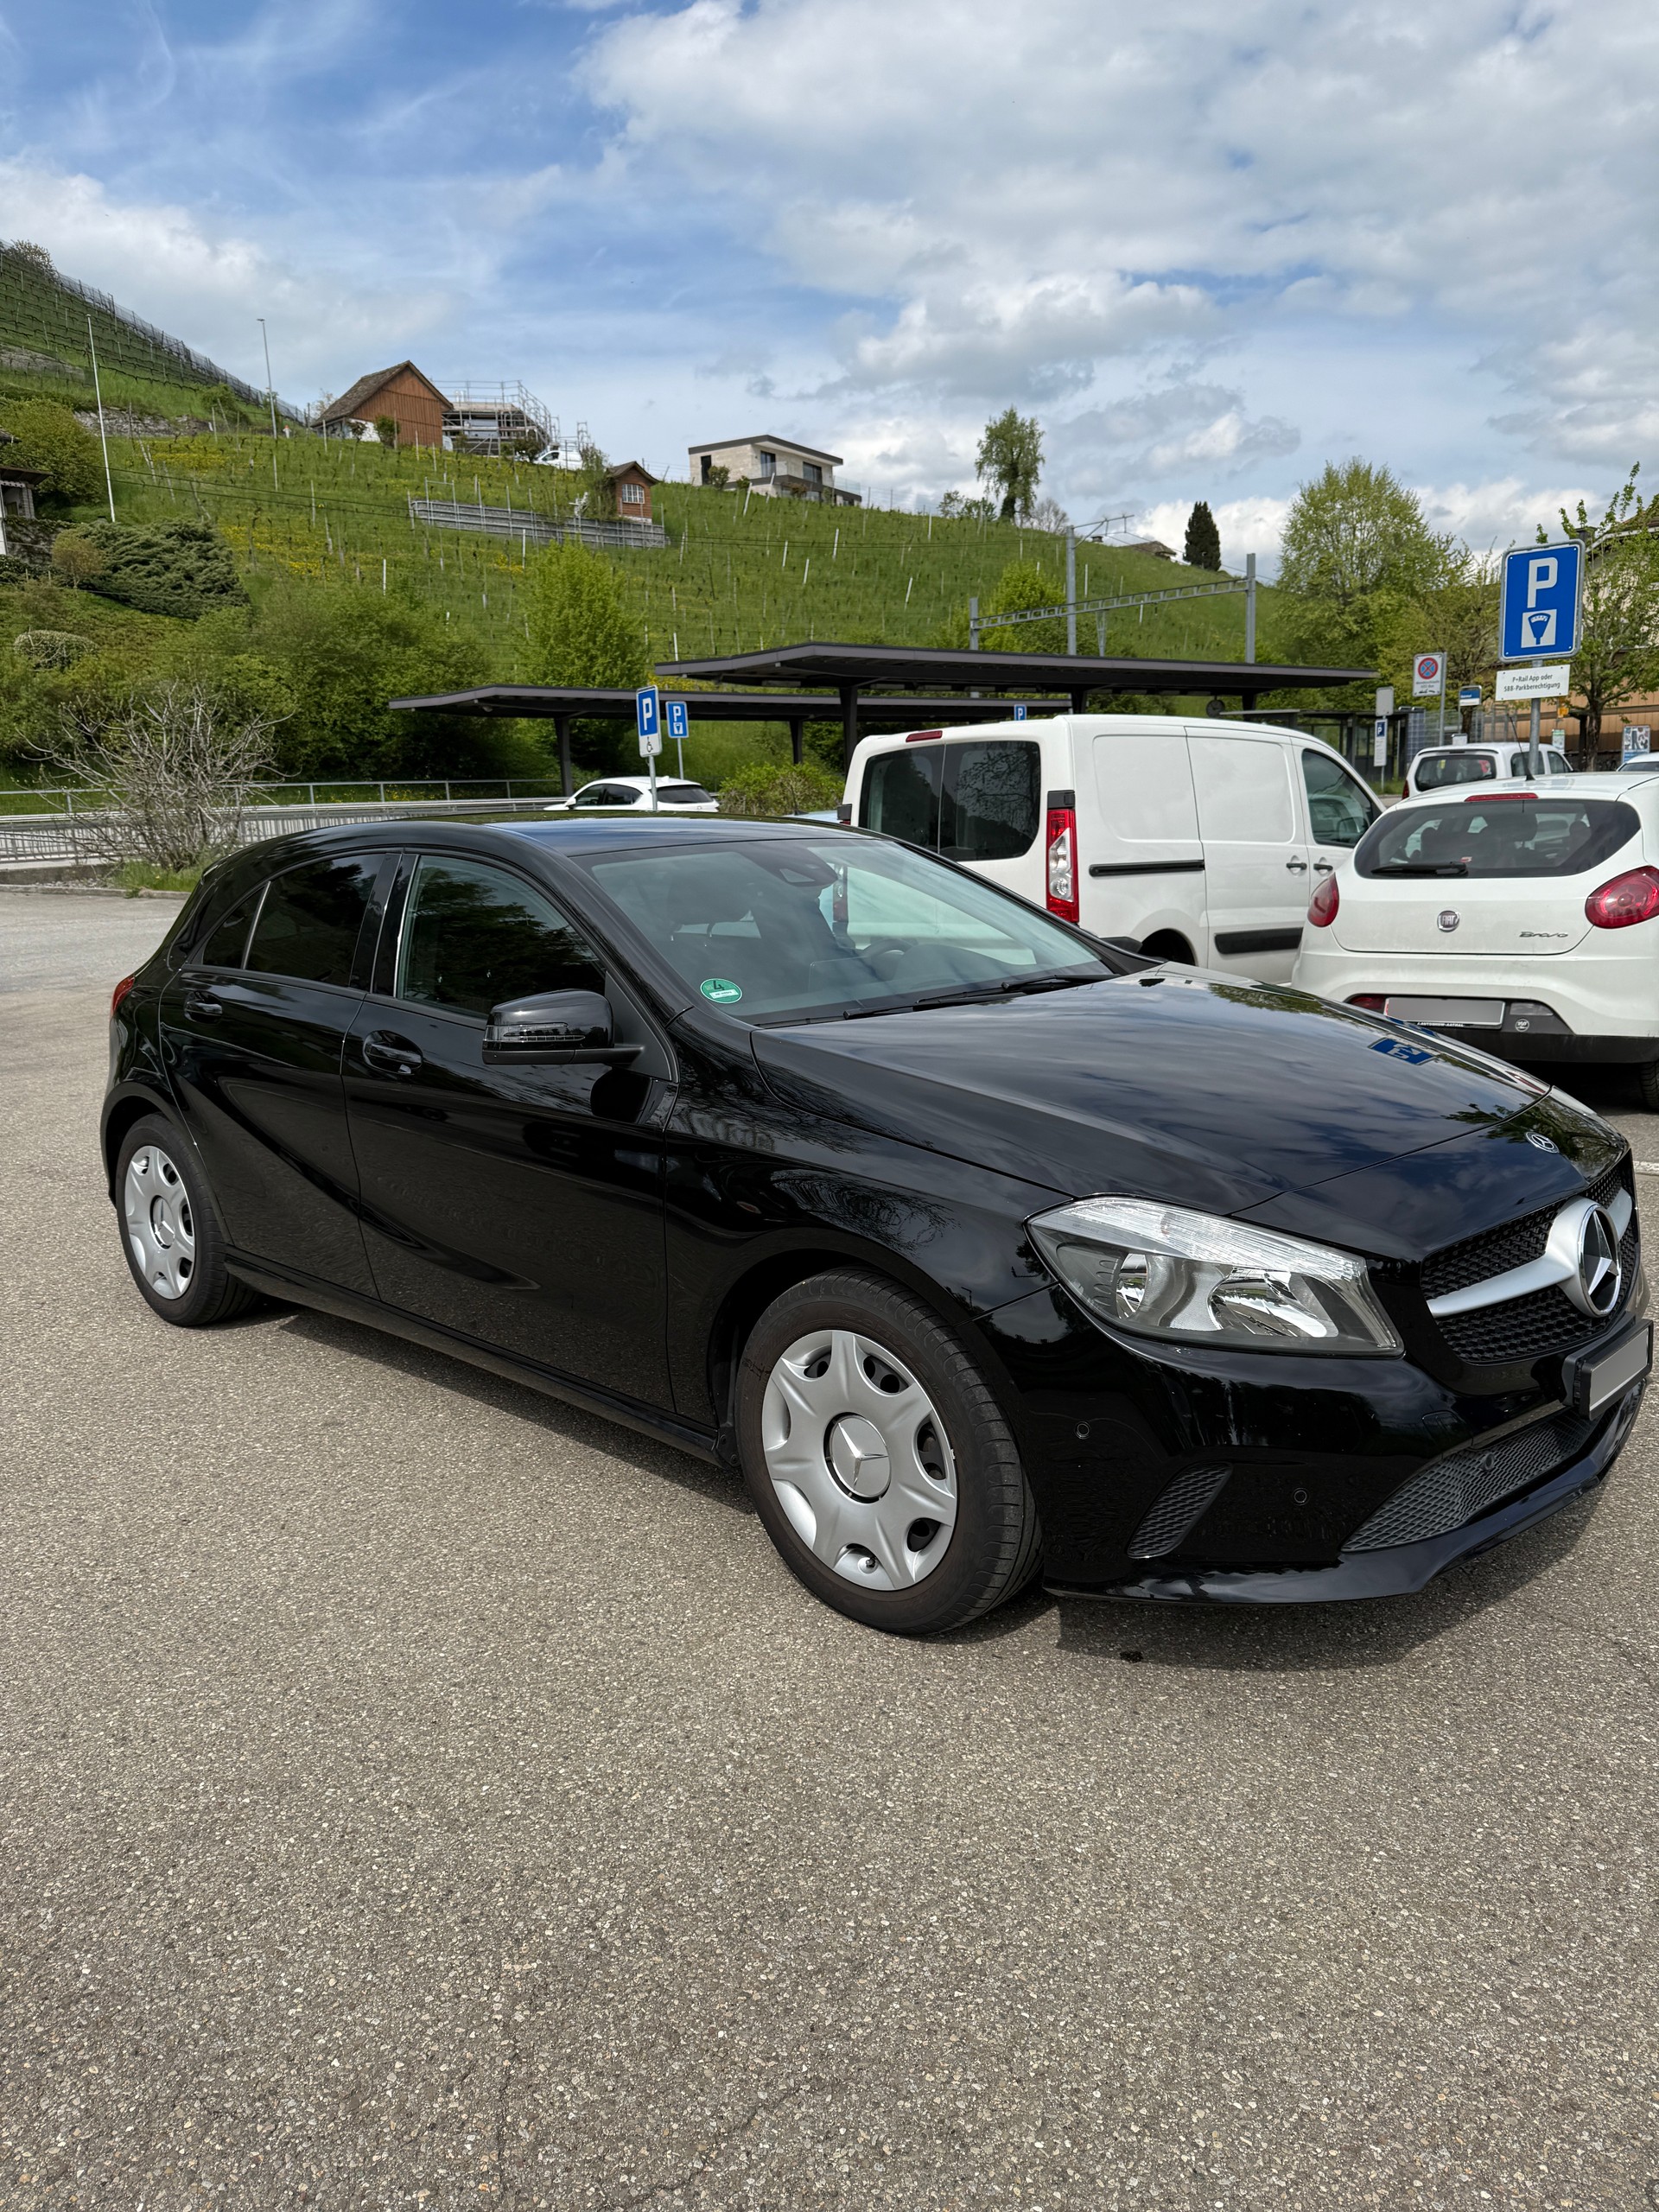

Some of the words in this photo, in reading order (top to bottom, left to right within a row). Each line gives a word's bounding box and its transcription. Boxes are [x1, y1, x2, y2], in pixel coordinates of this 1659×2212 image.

[1527, 556, 1558, 608] P
[1503, 683, 1560, 692] SBB-Parkberechtigung
[642, 698, 652, 730] P
[672, 706, 681, 721] P
[1018, 708, 1023, 721] P
[1441, 915, 1456, 925] FIAT
[713, 980, 724, 990] 4
